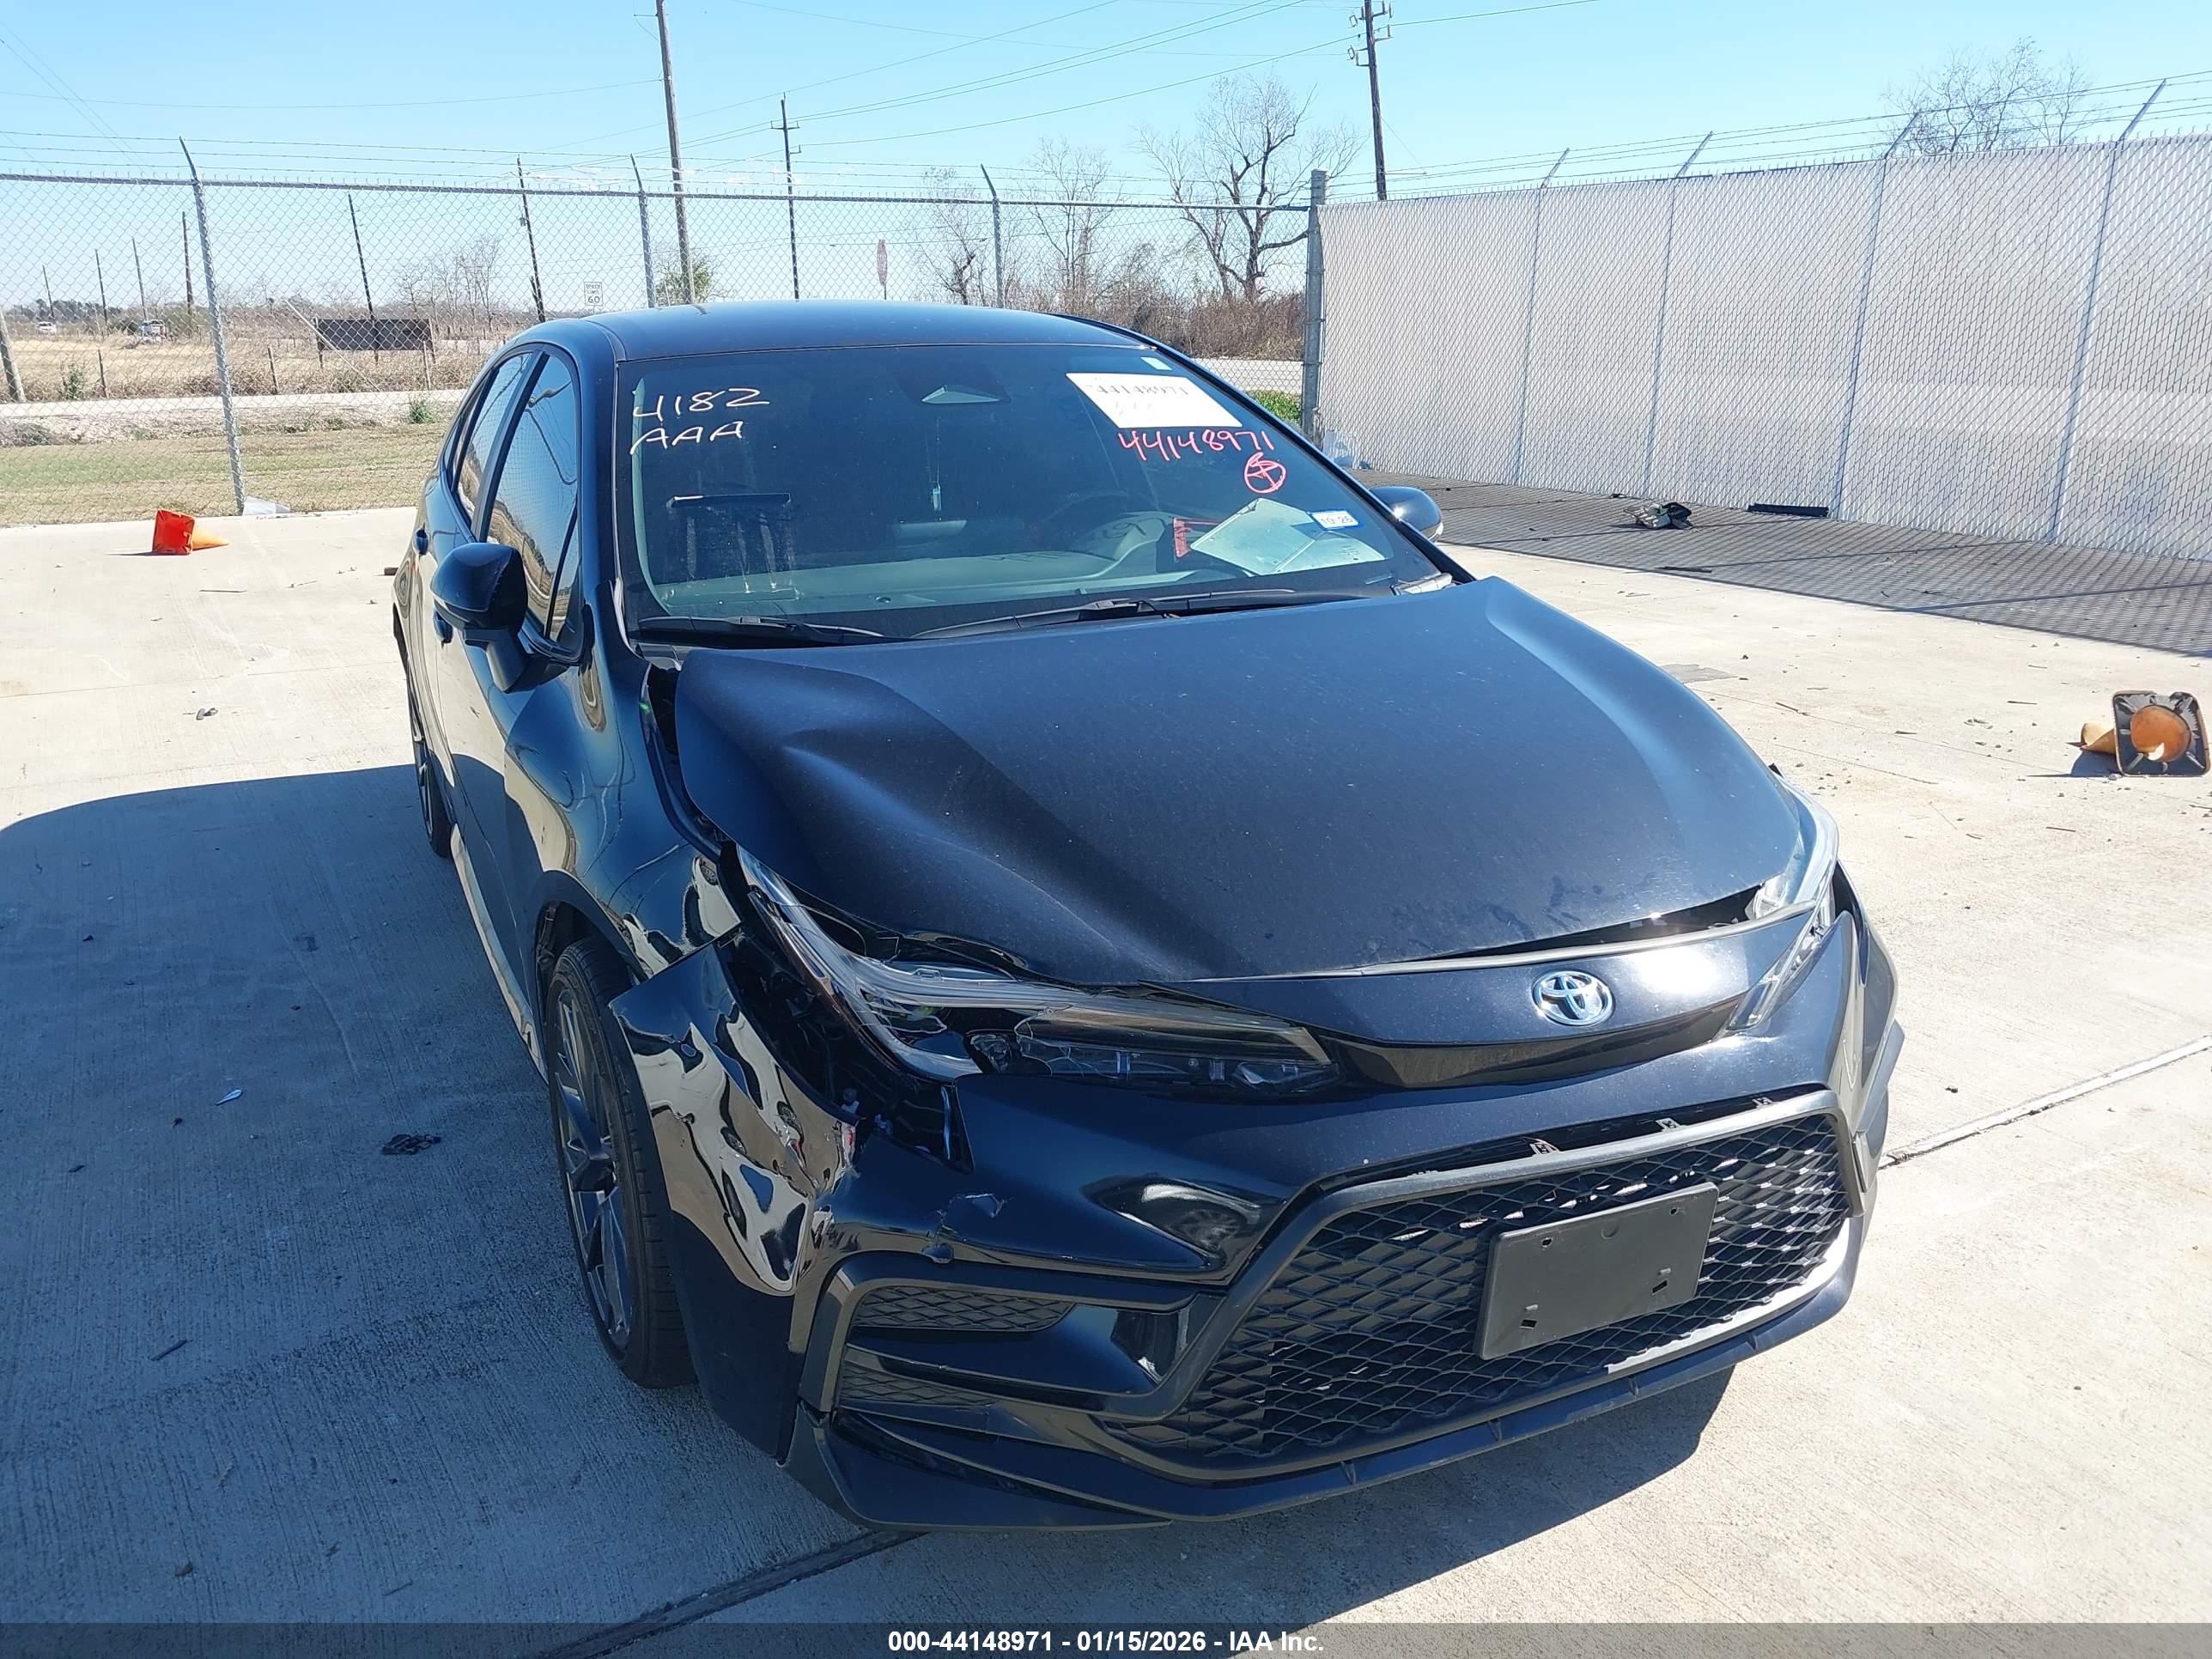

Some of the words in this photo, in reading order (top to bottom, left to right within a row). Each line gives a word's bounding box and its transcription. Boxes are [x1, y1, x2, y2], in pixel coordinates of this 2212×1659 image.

[633, 388, 769, 422] 4182
[629, 421, 744, 455] AAA
[1118, 429, 1275, 461] 44148971
